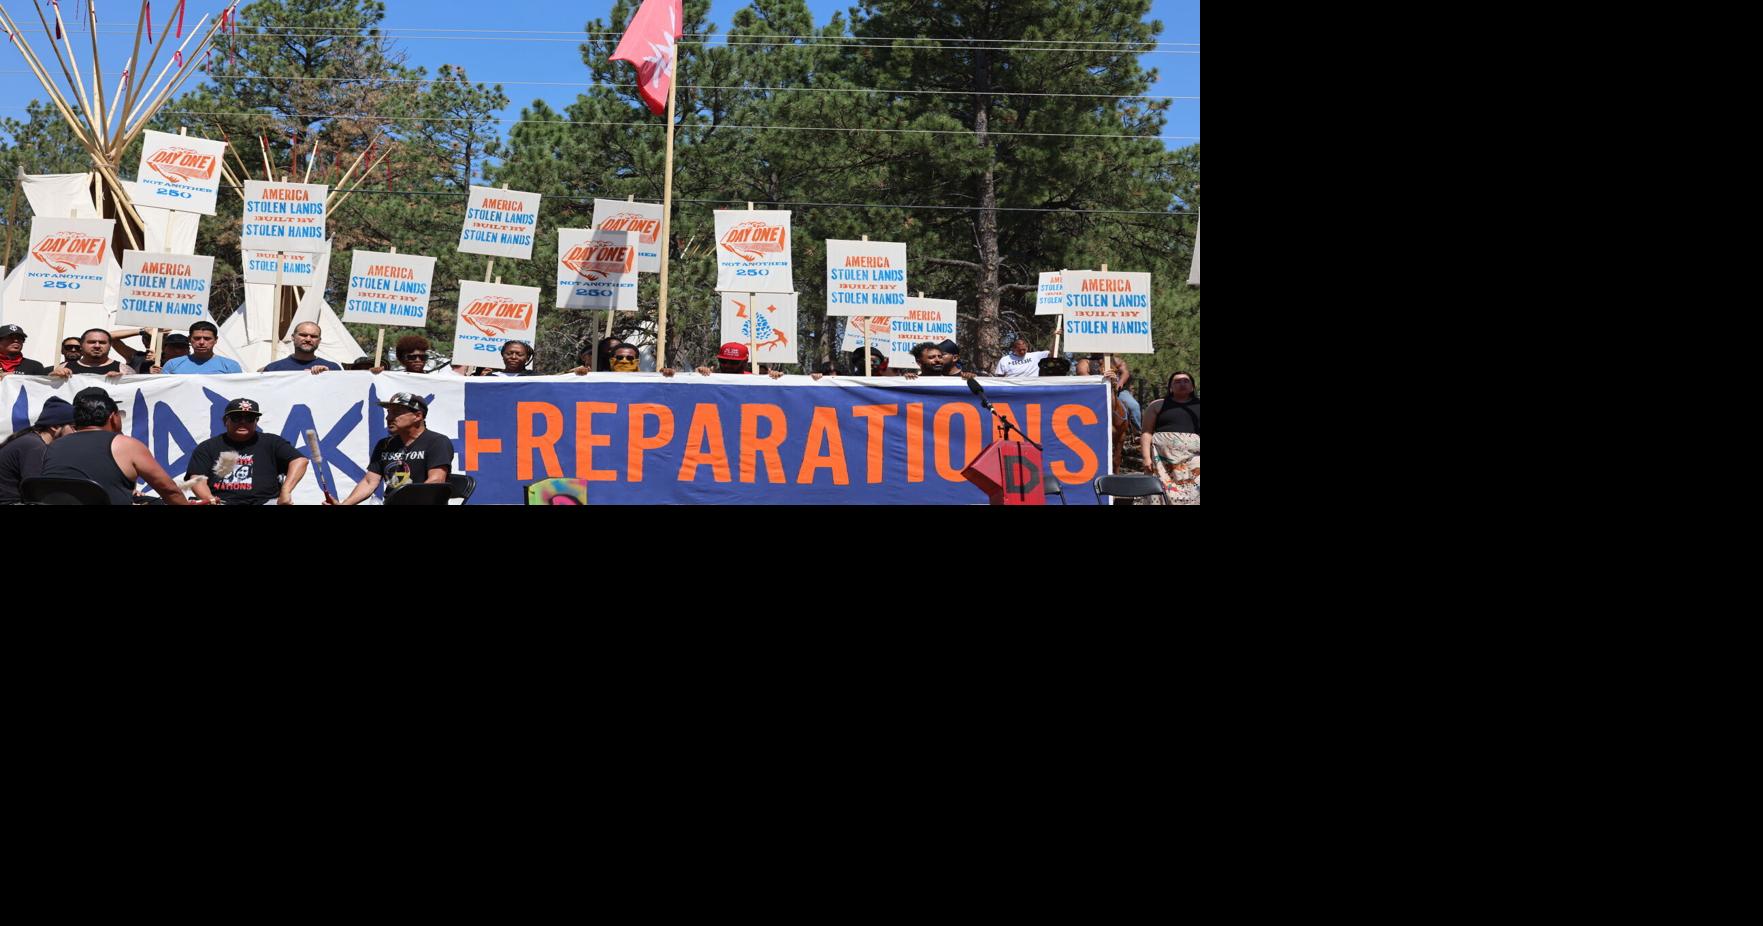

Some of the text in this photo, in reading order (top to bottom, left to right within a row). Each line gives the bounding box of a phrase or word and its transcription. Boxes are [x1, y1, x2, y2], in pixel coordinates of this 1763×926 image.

[154, 150, 211, 168] DAY ONE
[143, 179, 213, 193] NOT ANOTHER
[156, 188, 193, 199] 250
[262, 188, 309, 201] AMERICA
[247, 201, 323, 215] STOLEN LANDS
[482, 198, 523, 212] AMERICA
[254, 215, 295, 223] BUILT
[468, 208, 535, 225] STOLEN LANDS
[246, 224, 322, 238] STOLEN HANDS
[473, 222, 507, 230] BUILT
[603, 218, 656, 233] DAY ONE
[464, 229, 531, 246] STOLEN HANDS
[727, 227, 780, 243] DAY ONE
[40, 238, 100, 254] DAY ONE
[568, 246, 627, 262] DAY ONE
[283, 262, 311, 274] HANDS
[845, 256, 890, 268] AMERICA
[141, 262, 192, 277] AMERICA
[368, 265, 414, 280] AMERICA
[831, 268, 904, 281] STOLEN LANDS
[51, 273, 103, 281] ANOTHER
[124, 274, 205, 291] STOLEN LANDS
[42, 281, 81, 290] 250
[351, 276, 426, 294] STOLEN LANDS
[1081, 279, 1132, 292] AMERICA
[132, 290, 174, 298] BUILT
[358, 291, 398, 300] BUILT
[575, 288, 613, 297] 250
[831, 292, 905, 305] STOLEN HANDS
[122, 299, 203, 316] STOLEN HANDS
[1066, 294, 1147, 308] STOLEN LANDS
[348, 300, 424, 318] STOLEN HANDS
[468, 301, 527, 319] DAY ONE
[892, 320, 953, 333] STOLEN LANDS
[1067, 320, 1148, 334] STOLEN HANDS
